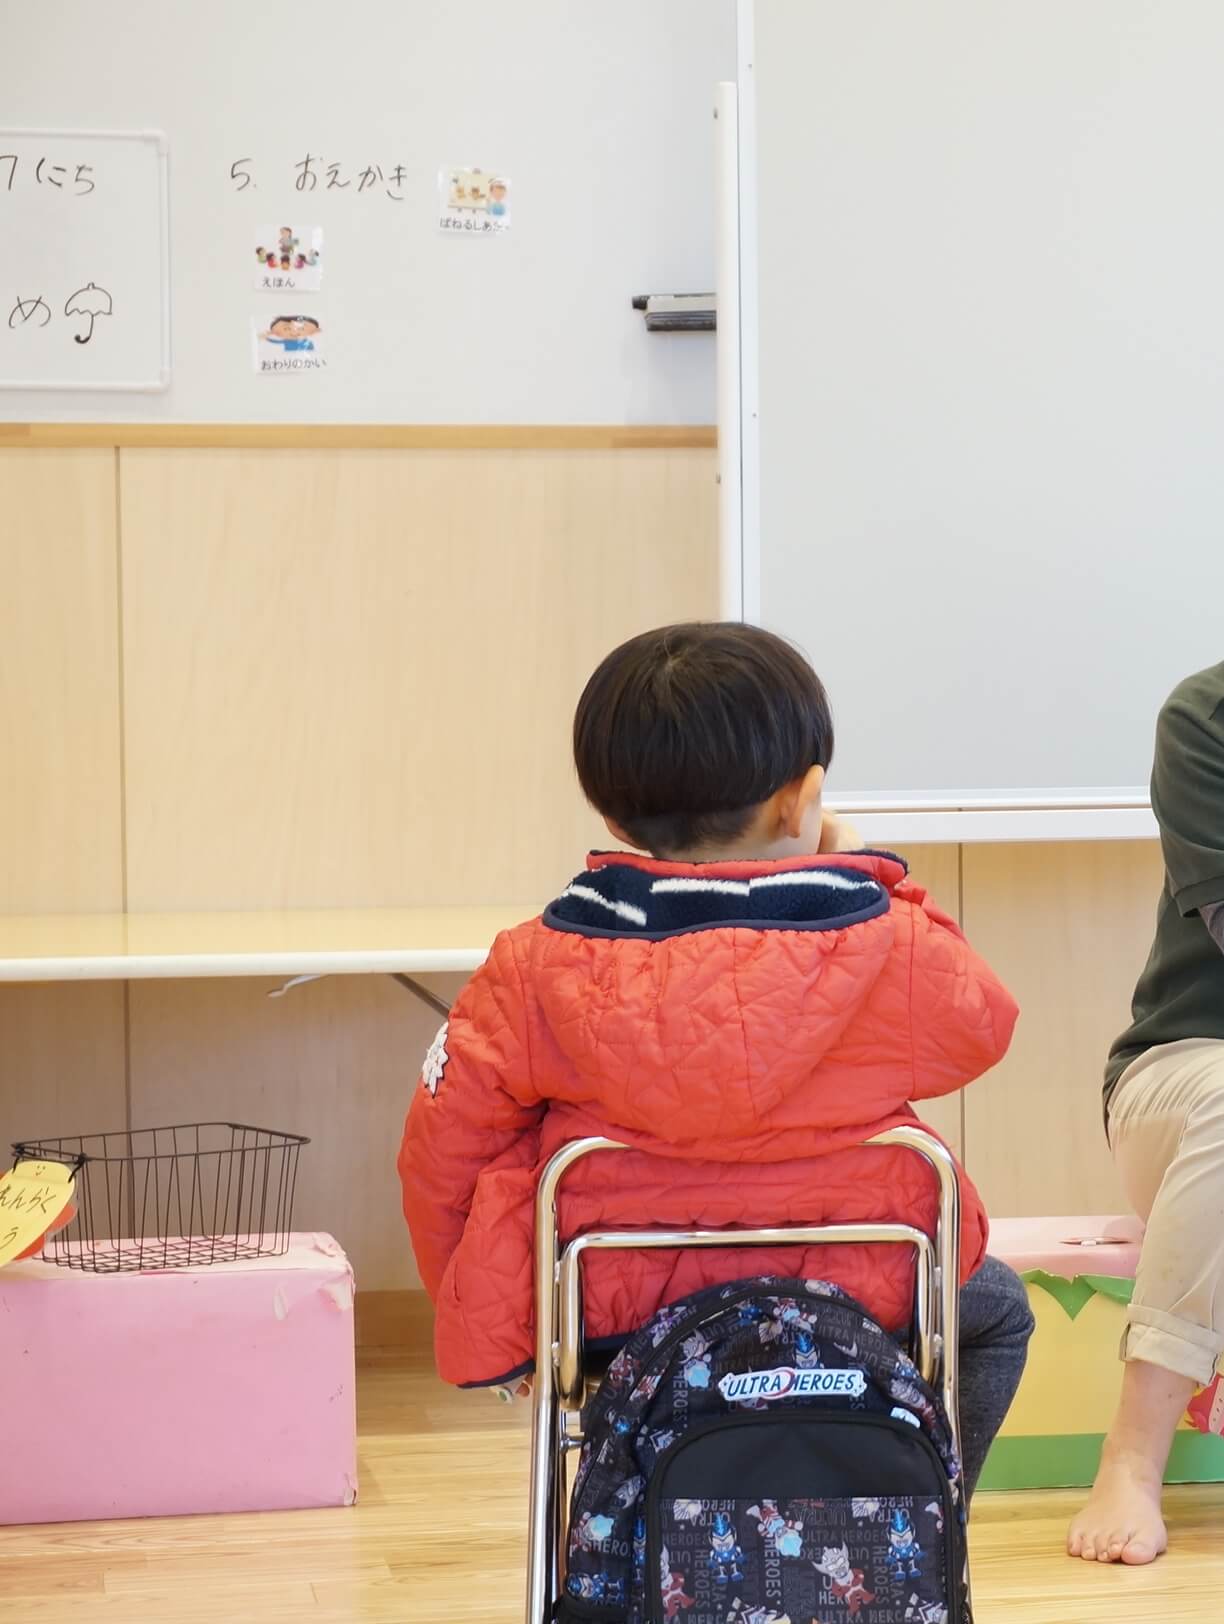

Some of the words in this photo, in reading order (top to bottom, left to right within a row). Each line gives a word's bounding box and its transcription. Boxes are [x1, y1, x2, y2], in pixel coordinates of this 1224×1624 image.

[295, 152, 407, 200] おえかき
[262, 276, 295, 288] えほん
[261, 359, 327, 371] おわりのかい
[727, 1374, 782, 1397] ULTRA
[787, 1373, 855, 1392] HEROES
